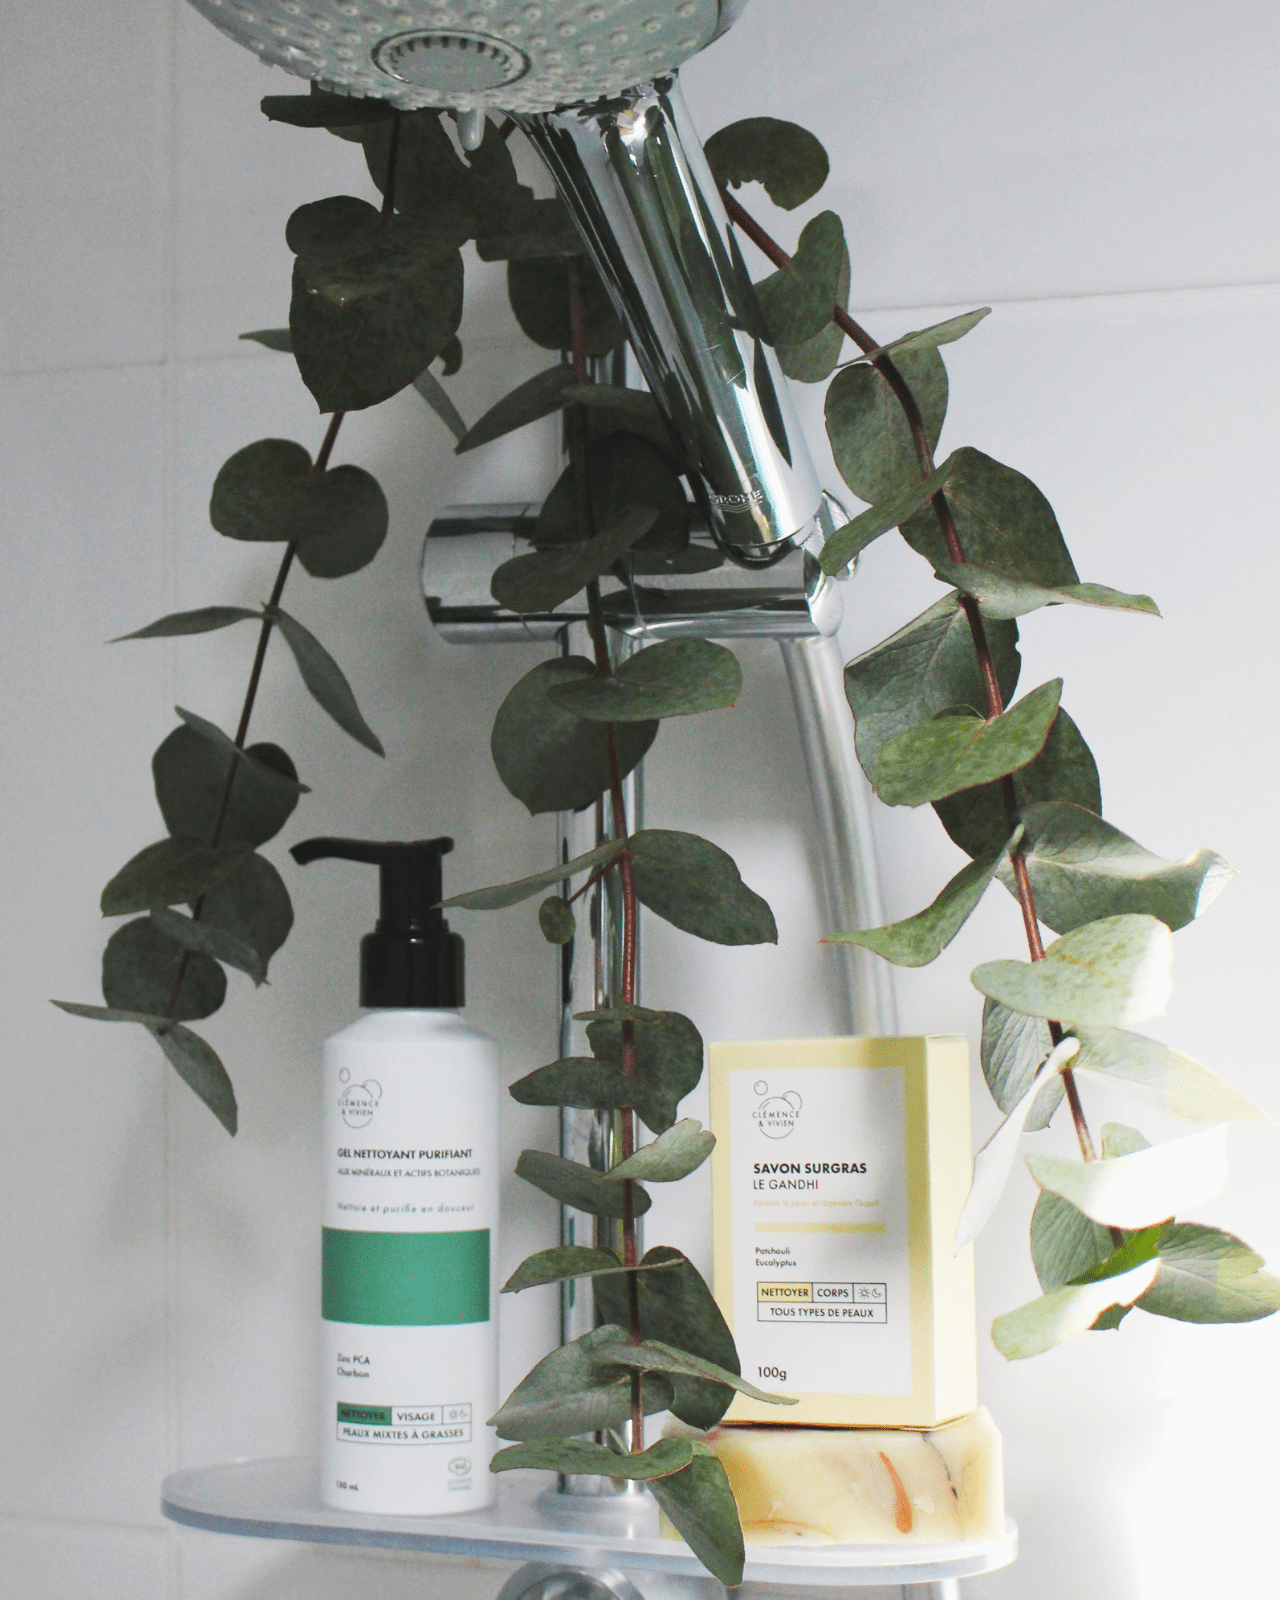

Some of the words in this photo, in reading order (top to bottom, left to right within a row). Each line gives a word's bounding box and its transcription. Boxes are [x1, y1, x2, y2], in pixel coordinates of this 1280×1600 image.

[751, 1110, 800, 1119] CLÉMENCE
[767, 1119, 795, 1127] VIVIEN
[337, 1148, 352, 1158] GEL
[354, 1149, 416, 1159] NETTOYANT
[418, 1149, 473, 1159] PURIFIANT
[337, 1167, 350, 1176] AUX
[351, 1167, 392, 1177] MINÉRAUX
[404, 1170, 432, 1178] ACTIFS
[434, 1167, 481, 1177] BOTANIQUES
[753, 1162, 801, 1174] SAVON
[804, 1162, 868, 1174] SURGRAS
[753, 1179, 765, 1190] LE
[768, 1179, 819, 1190] GANDHI
[370, 1204, 380, 1212] et
[382, 1203, 417, 1215] purifie
[421, 1205, 434, 1213] en
[437, 1203, 475, 1213] douceur
[755, 1247, 791, 1255] Patchouli
[755, 1258, 797, 1268] Eucalyptus
[761, 1288, 809, 1297] NETTOYER
[816, 1288, 849, 1298] CORPS
[770, 1307, 796, 1317] TOUS
[798, 1308, 826, 1317] TYPES
[827, 1308, 840, 1317] DE
[842, 1308, 875, 1318] PEAUX
[352, 1354, 371, 1365] PCA
[336, 1366, 370, 1378] Charbon
[757, 1366, 787, 1382] 100g
[396, 1412, 436, 1421] VISAGE
[342, 1427, 370, 1439] PEAUX
[372, 1430, 409, 1440] MIXTES
[411, 1428, 419, 1439] À
[421, 1428, 464, 1440] GRASSES
